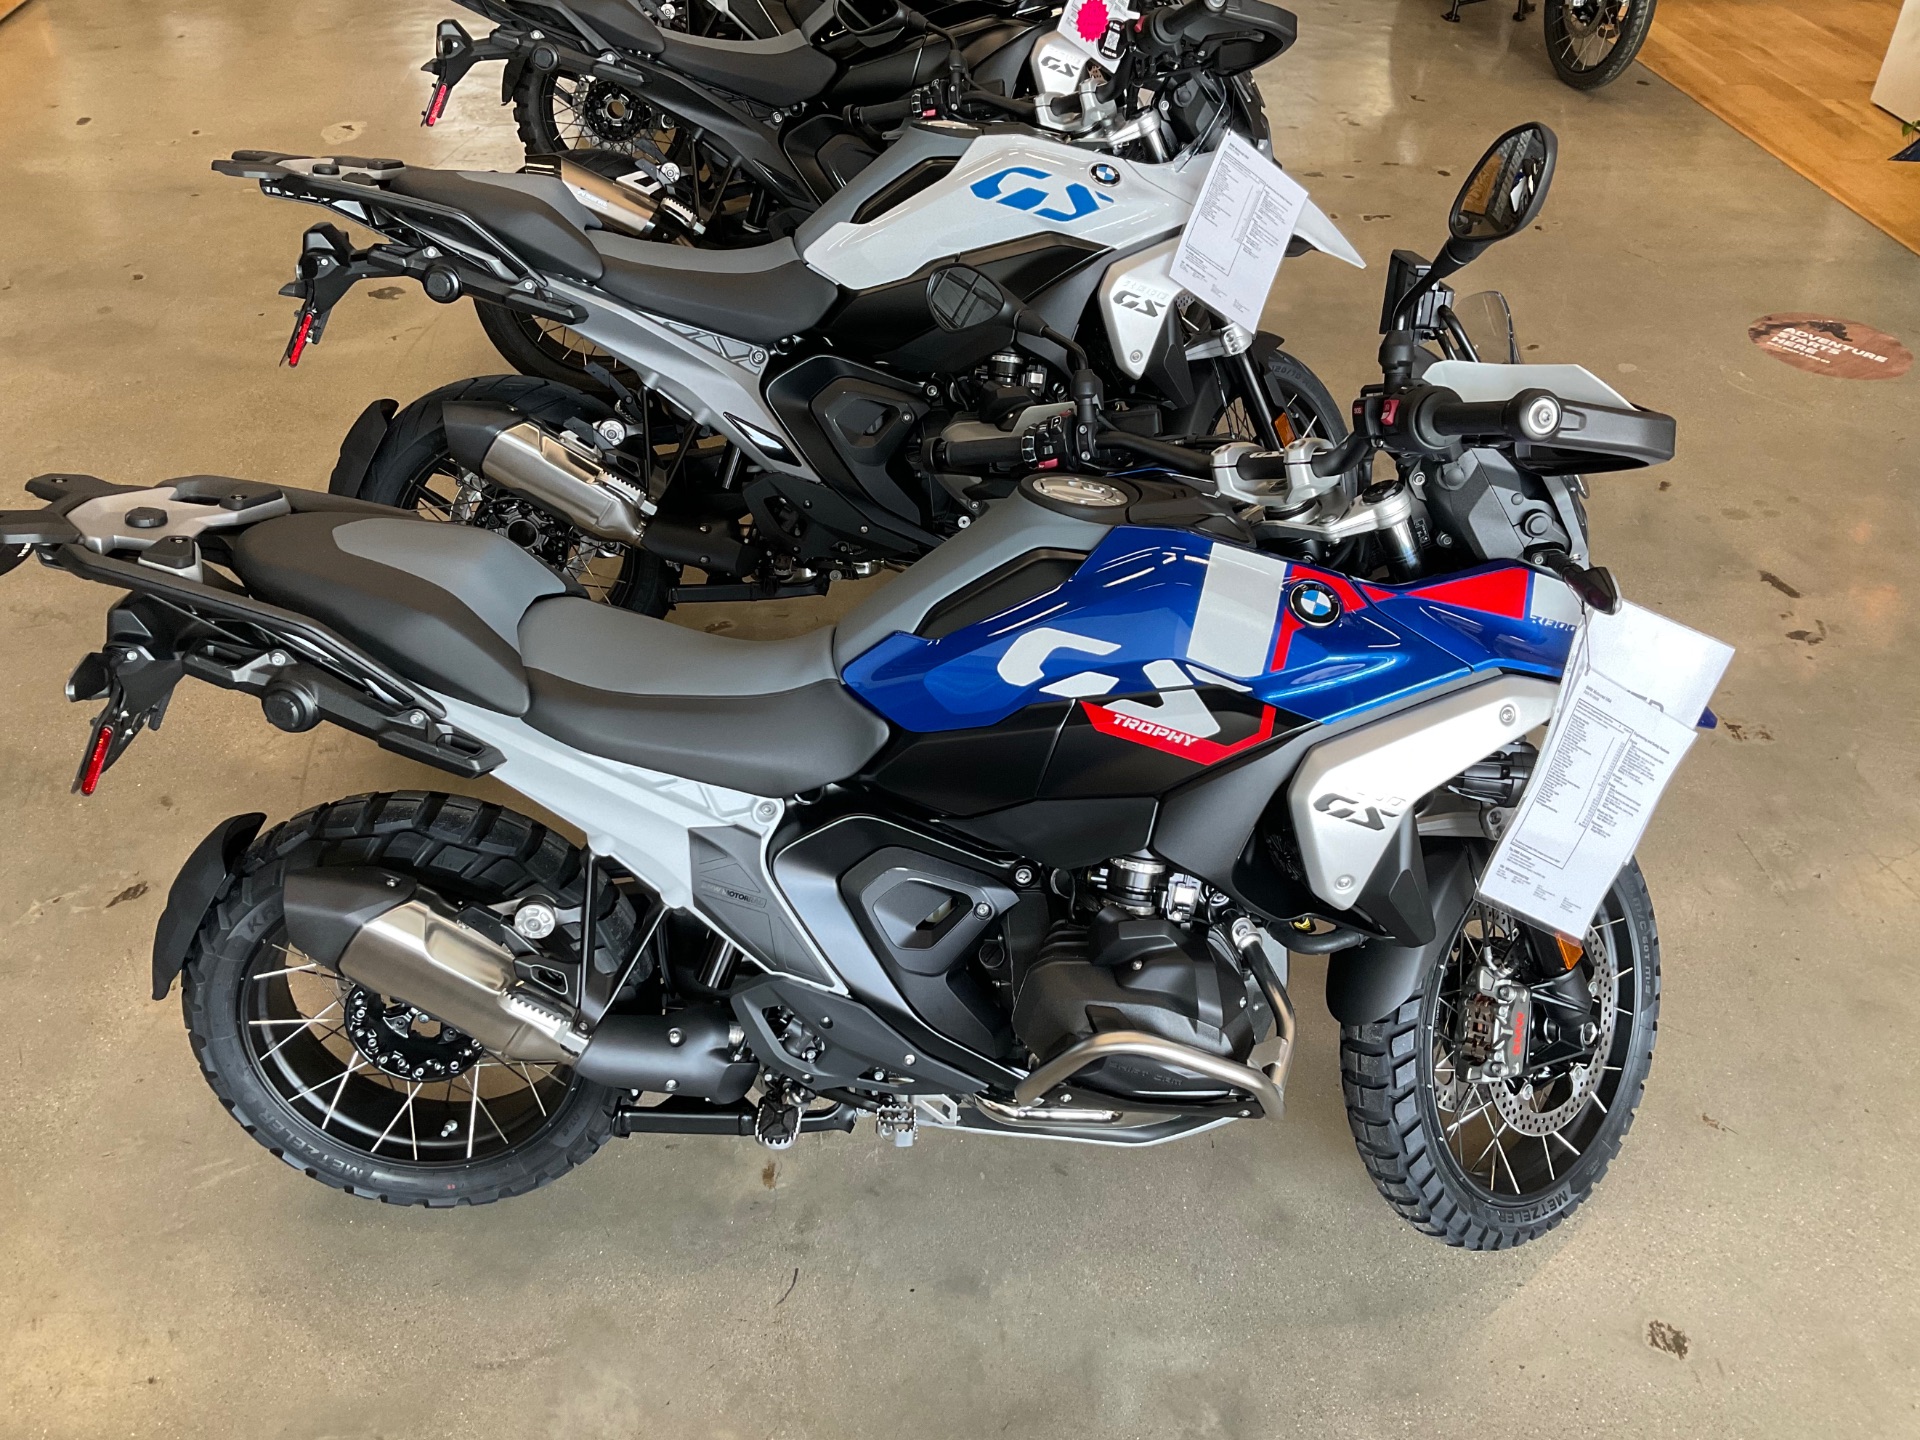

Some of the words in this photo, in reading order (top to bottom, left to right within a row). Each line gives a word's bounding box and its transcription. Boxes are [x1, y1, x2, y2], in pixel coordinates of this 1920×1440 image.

[1041, 56, 1080, 78] GS
[970, 166, 1115, 223] GS
[1112, 290, 1166, 318] GS
[1771, 336, 1819, 355] HERE
[1777, 331, 1842, 355] STARTS
[1782, 327, 1888, 363] ADVENTURE
[996, 627, 1253, 739] GS
[1112, 713, 1199, 747] TROPHY
[1313, 792, 1400, 832] GS
[258, 1108, 364, 1179] METZELER
[1498, 1190, 1569, 1224] METZELER
